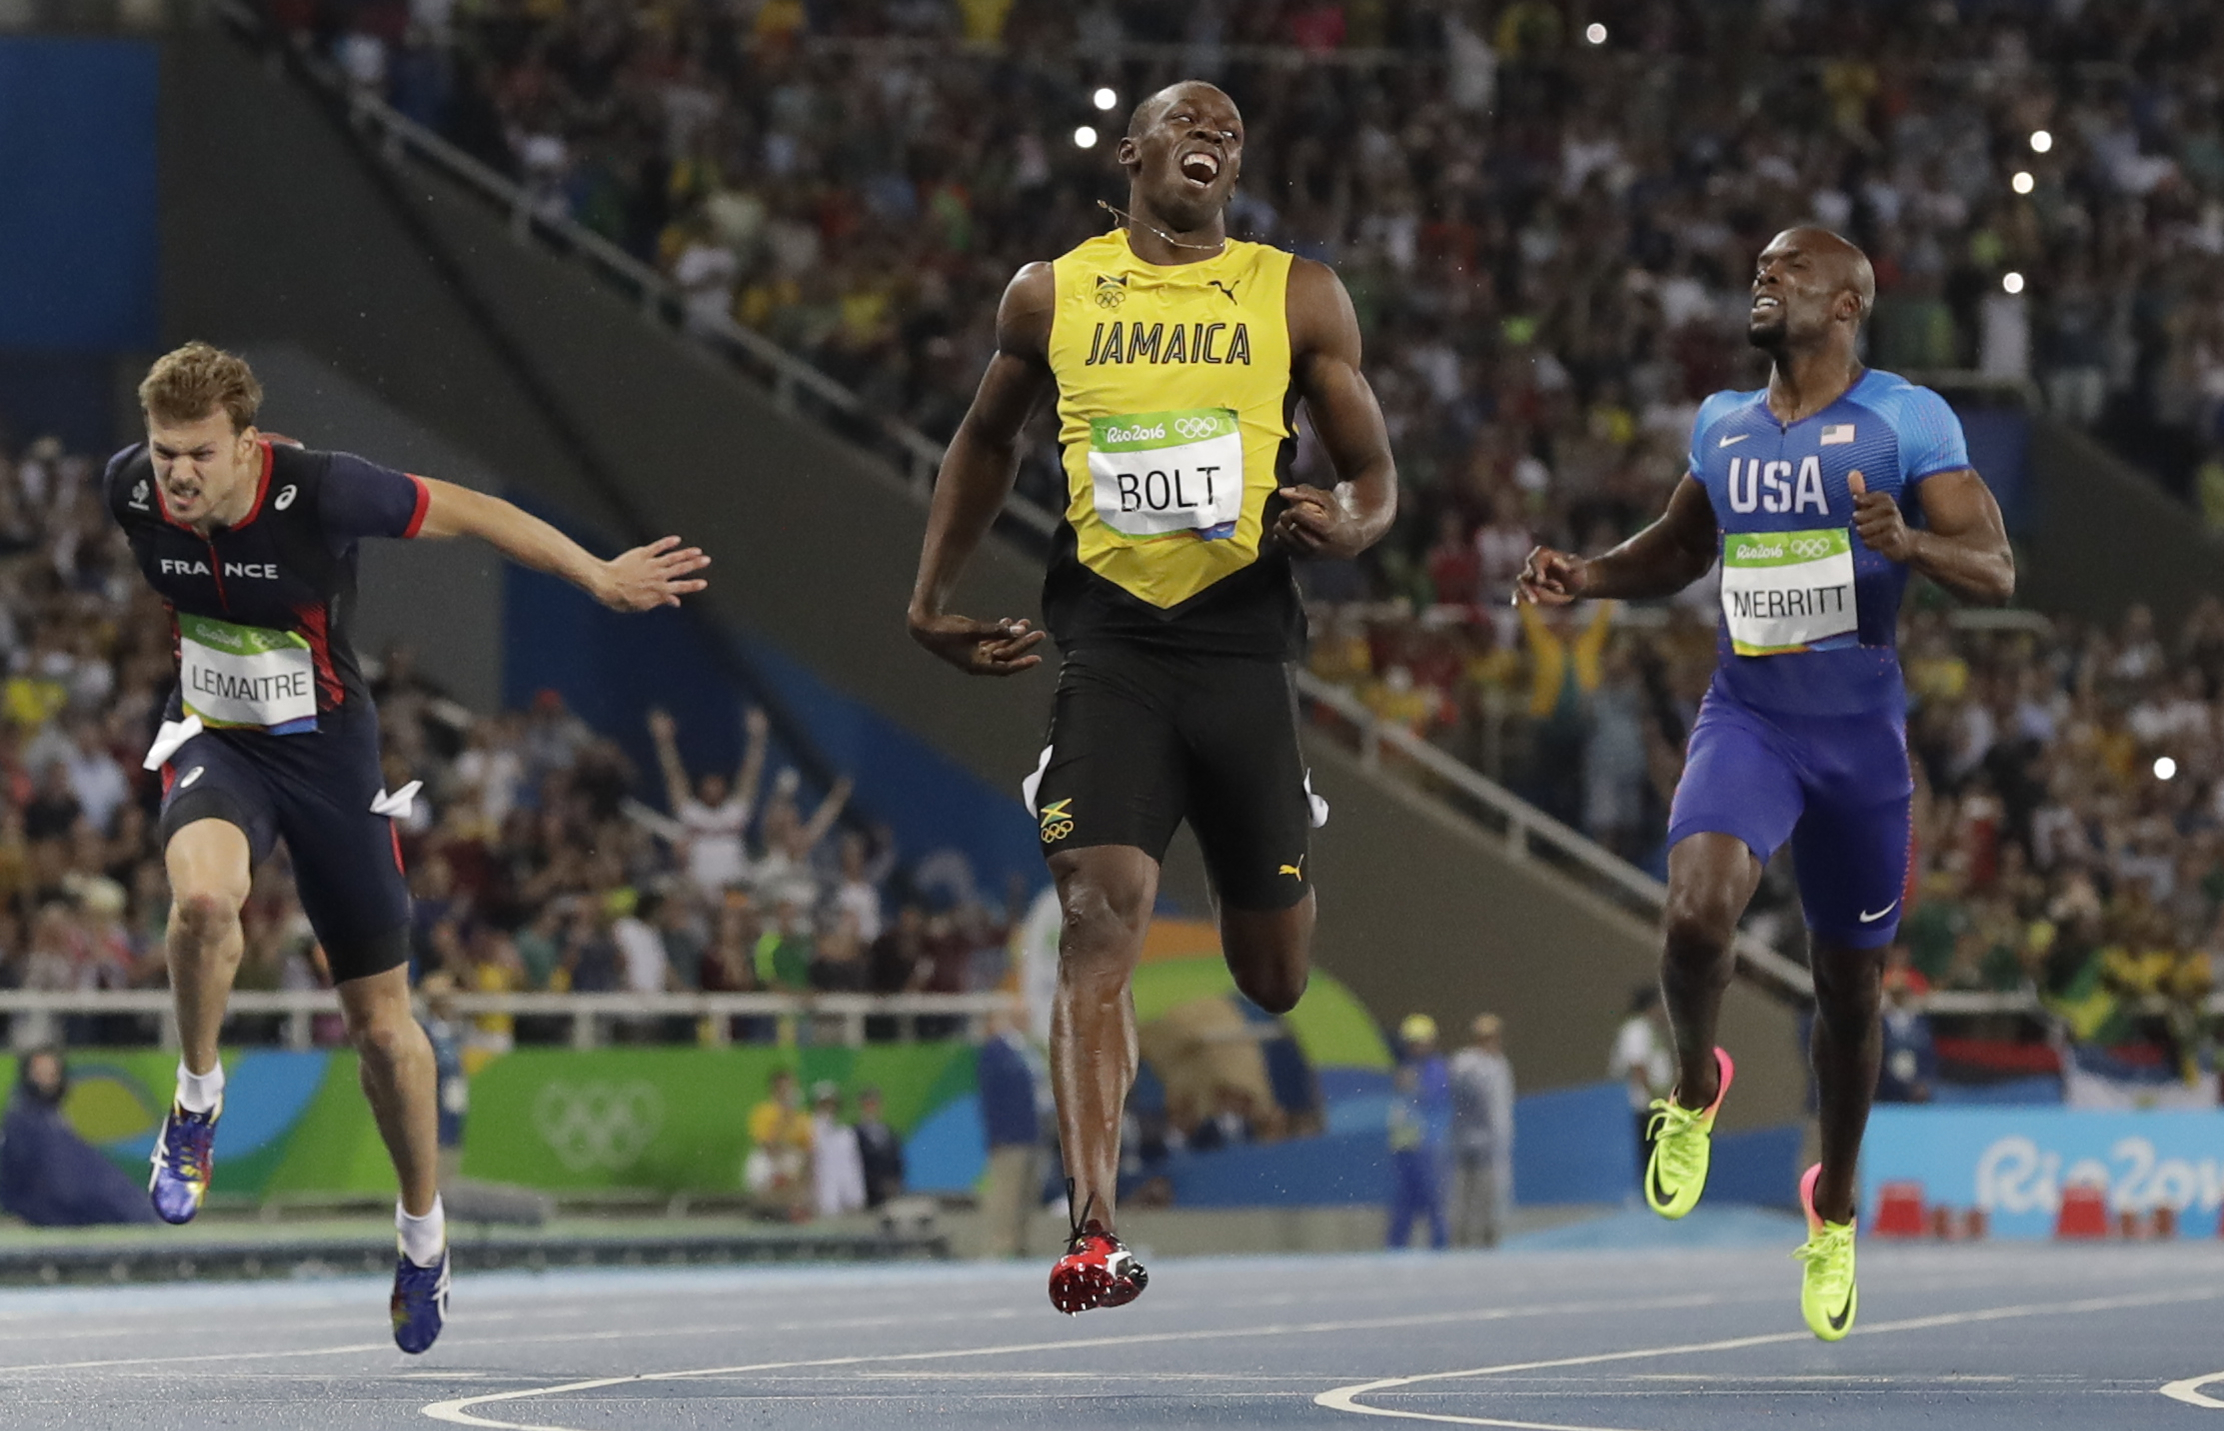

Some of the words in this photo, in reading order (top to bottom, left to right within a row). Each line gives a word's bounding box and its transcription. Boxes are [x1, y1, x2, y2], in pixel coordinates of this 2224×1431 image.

[1085, 321, 1251, 366] JAMAICA
[1107, 423, 1166, 443] Rio2016
[1117, 466, 1220, 512] BOLT
[1728, 455, 1830, 515] USA
[160, 559, 279, 580] FRANCE
[1733, 585, 1847, 618] MERRITT
[192, 665, 307, 701] LEMAITRE
